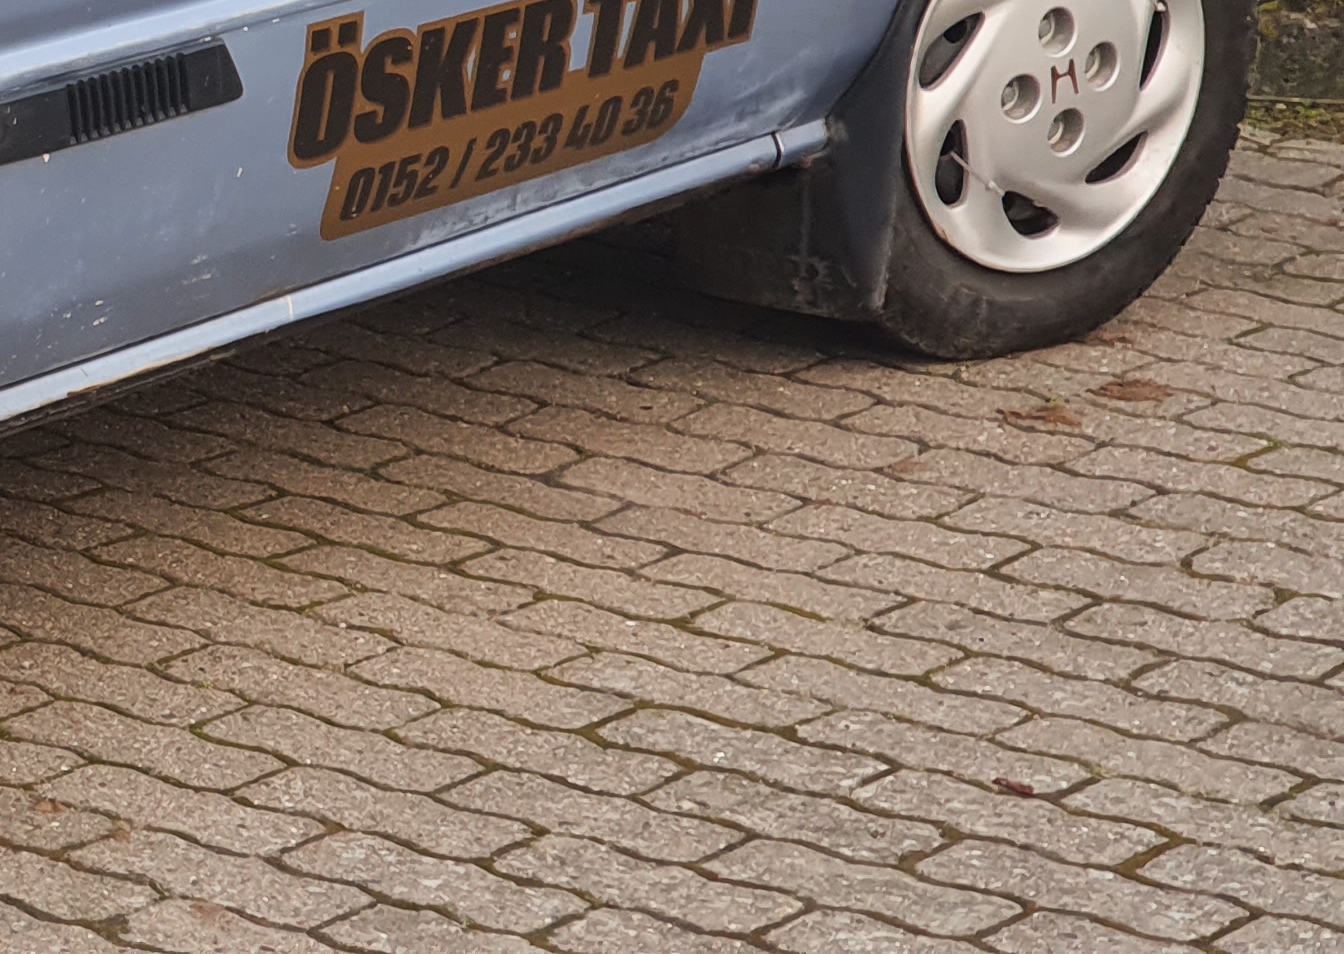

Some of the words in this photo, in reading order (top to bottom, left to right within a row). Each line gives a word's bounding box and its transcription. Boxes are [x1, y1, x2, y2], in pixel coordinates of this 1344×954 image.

[340, 146, 450, 222] 0152
[475, 112, 564, 181] 233
[563, 95, 622, 150] 40
[621, 79, 680, 136] 36
